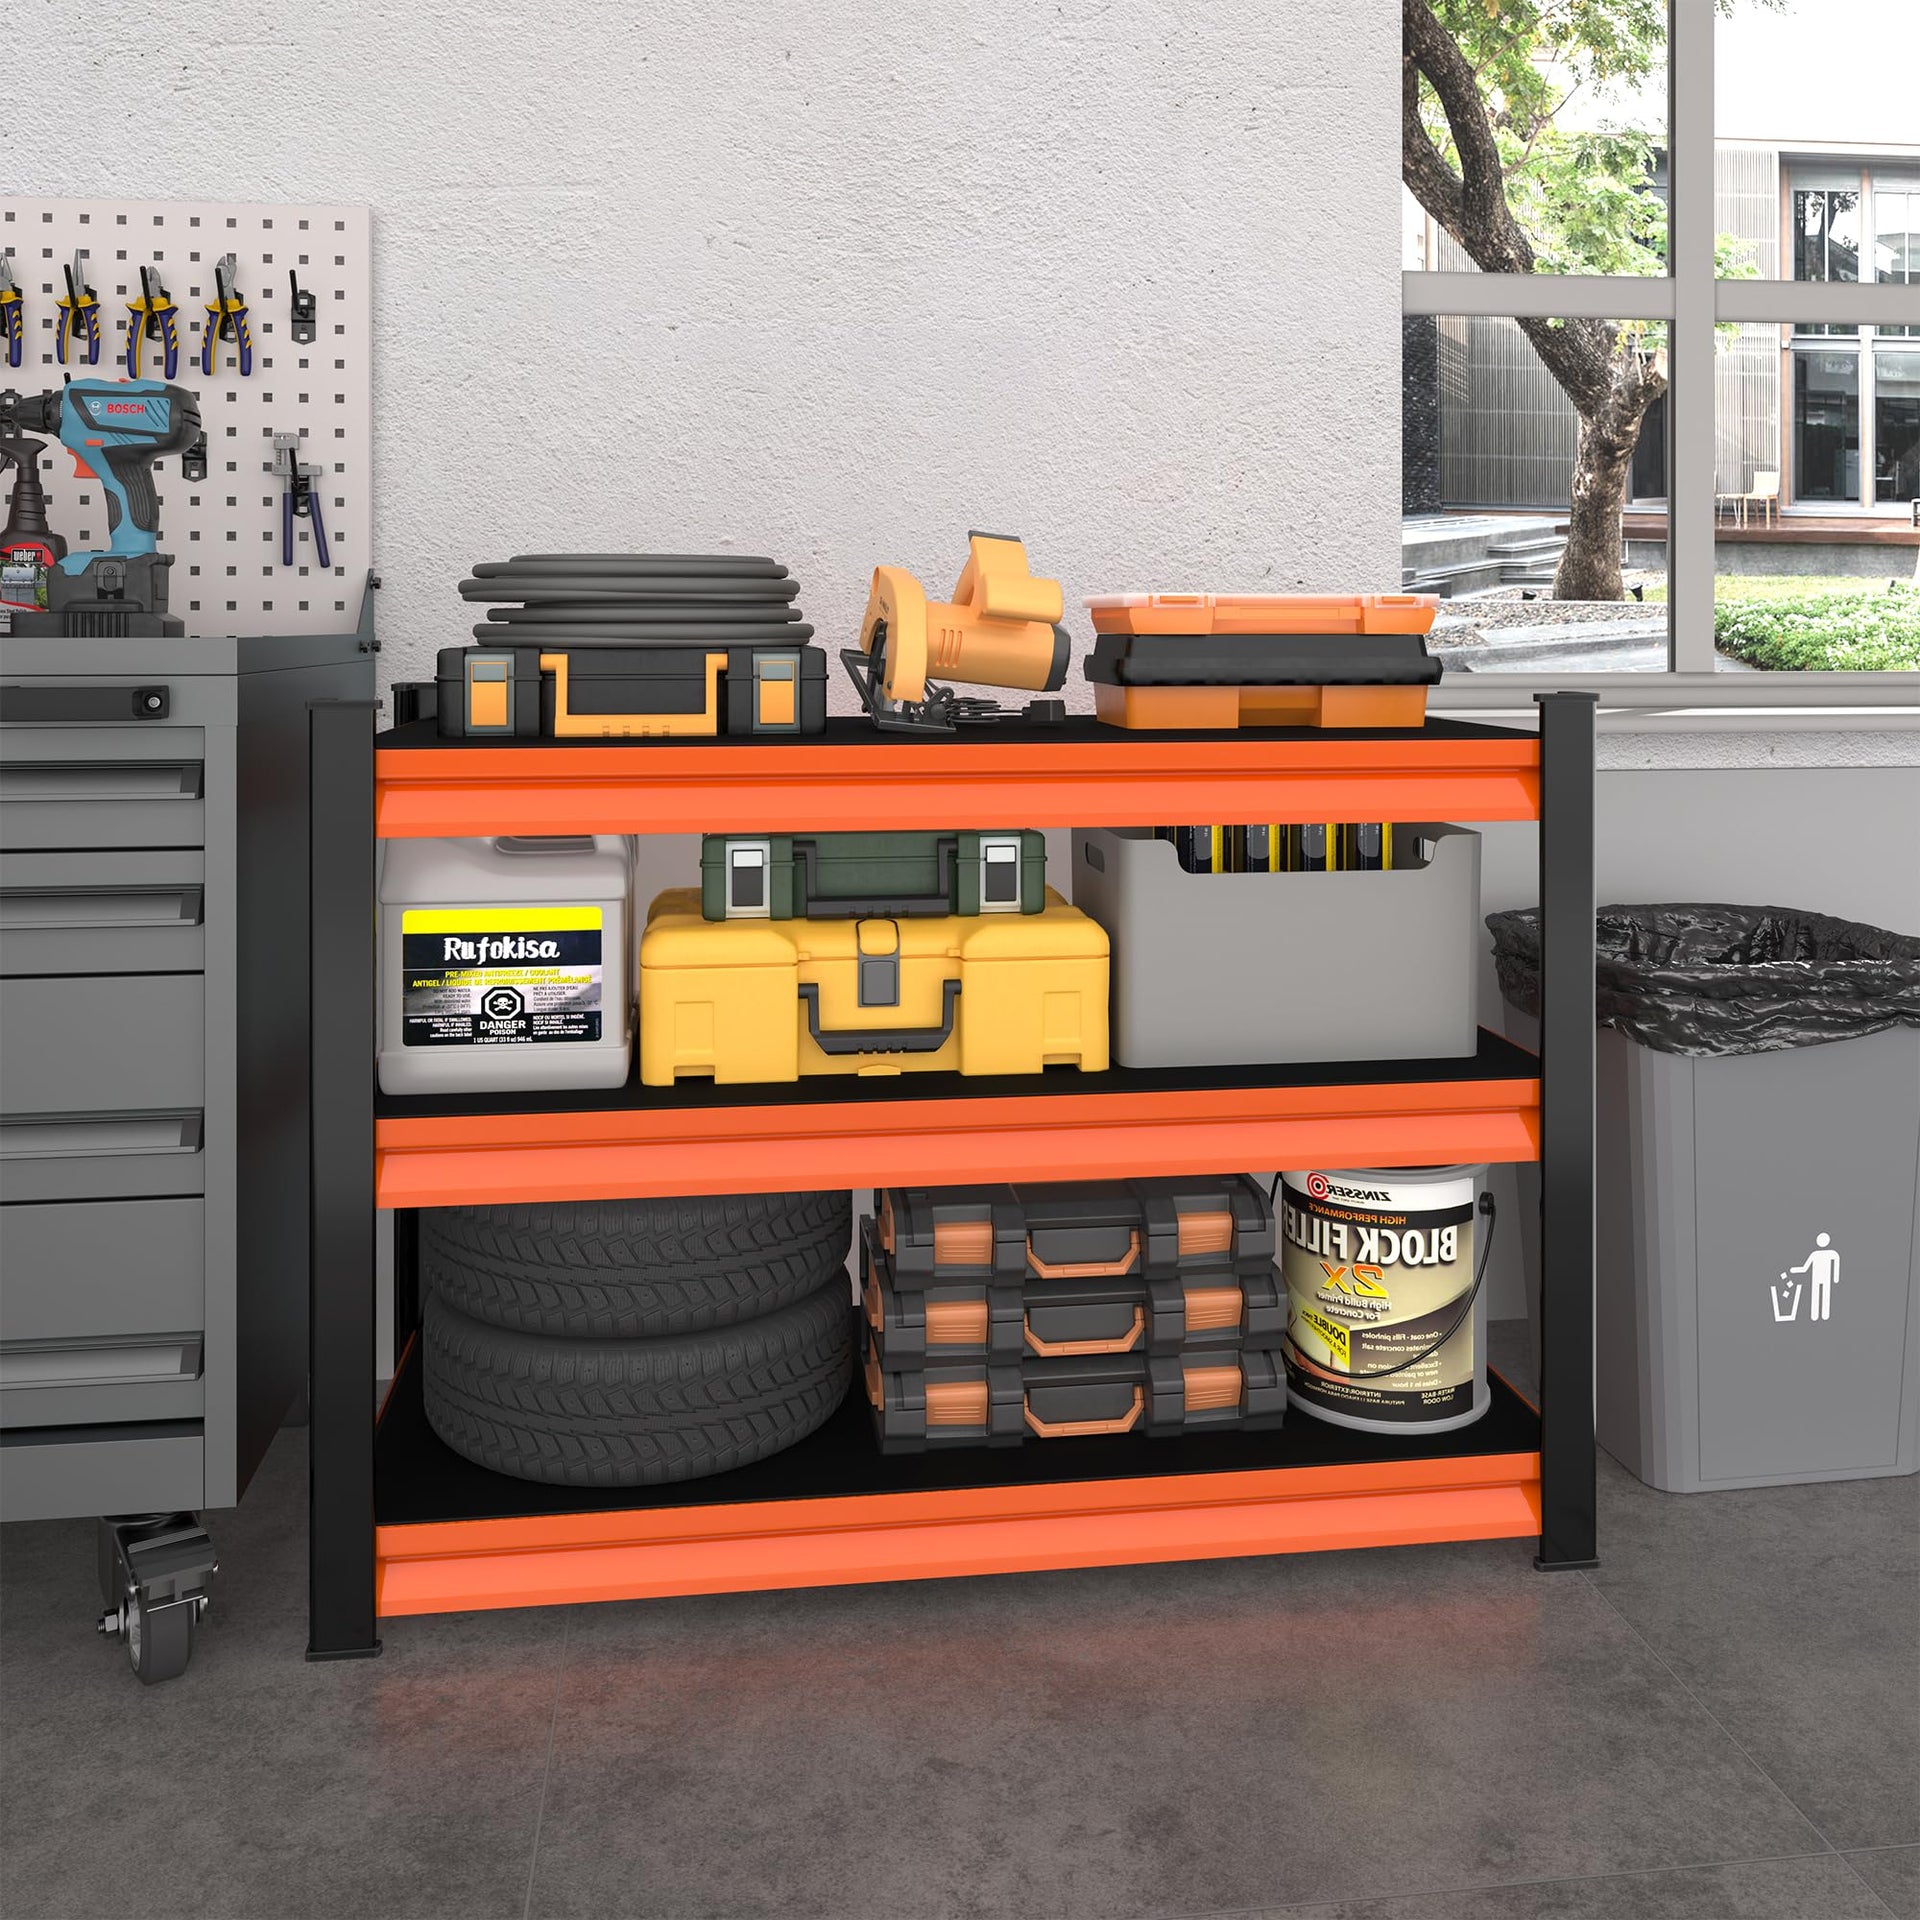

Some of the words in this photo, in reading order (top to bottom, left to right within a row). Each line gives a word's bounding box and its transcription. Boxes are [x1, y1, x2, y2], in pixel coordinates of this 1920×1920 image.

[107, 404, 145, 414] BOSCH
[13, 550, 35, 561] weber
[443, 936, 560, 964] Rufokisa
[480, 1021, 526, 1030] DANGER
